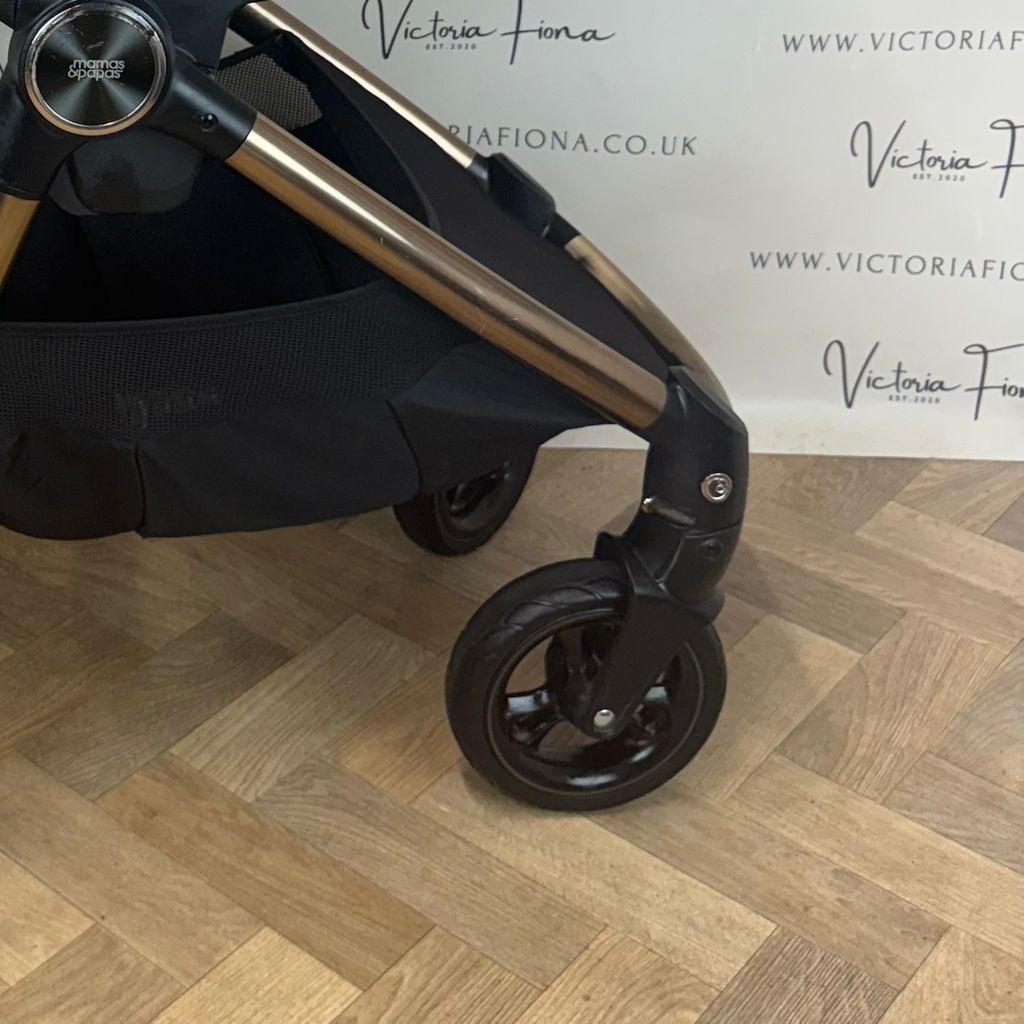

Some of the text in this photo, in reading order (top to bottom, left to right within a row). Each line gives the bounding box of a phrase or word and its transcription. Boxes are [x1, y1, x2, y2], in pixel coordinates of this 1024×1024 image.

[68, 64, 124, 81] &papas
[74, 59, 125, 70] mamas
[850, 120, 987, 188] Victoria
[823, 340, 961, 409] Victoria
